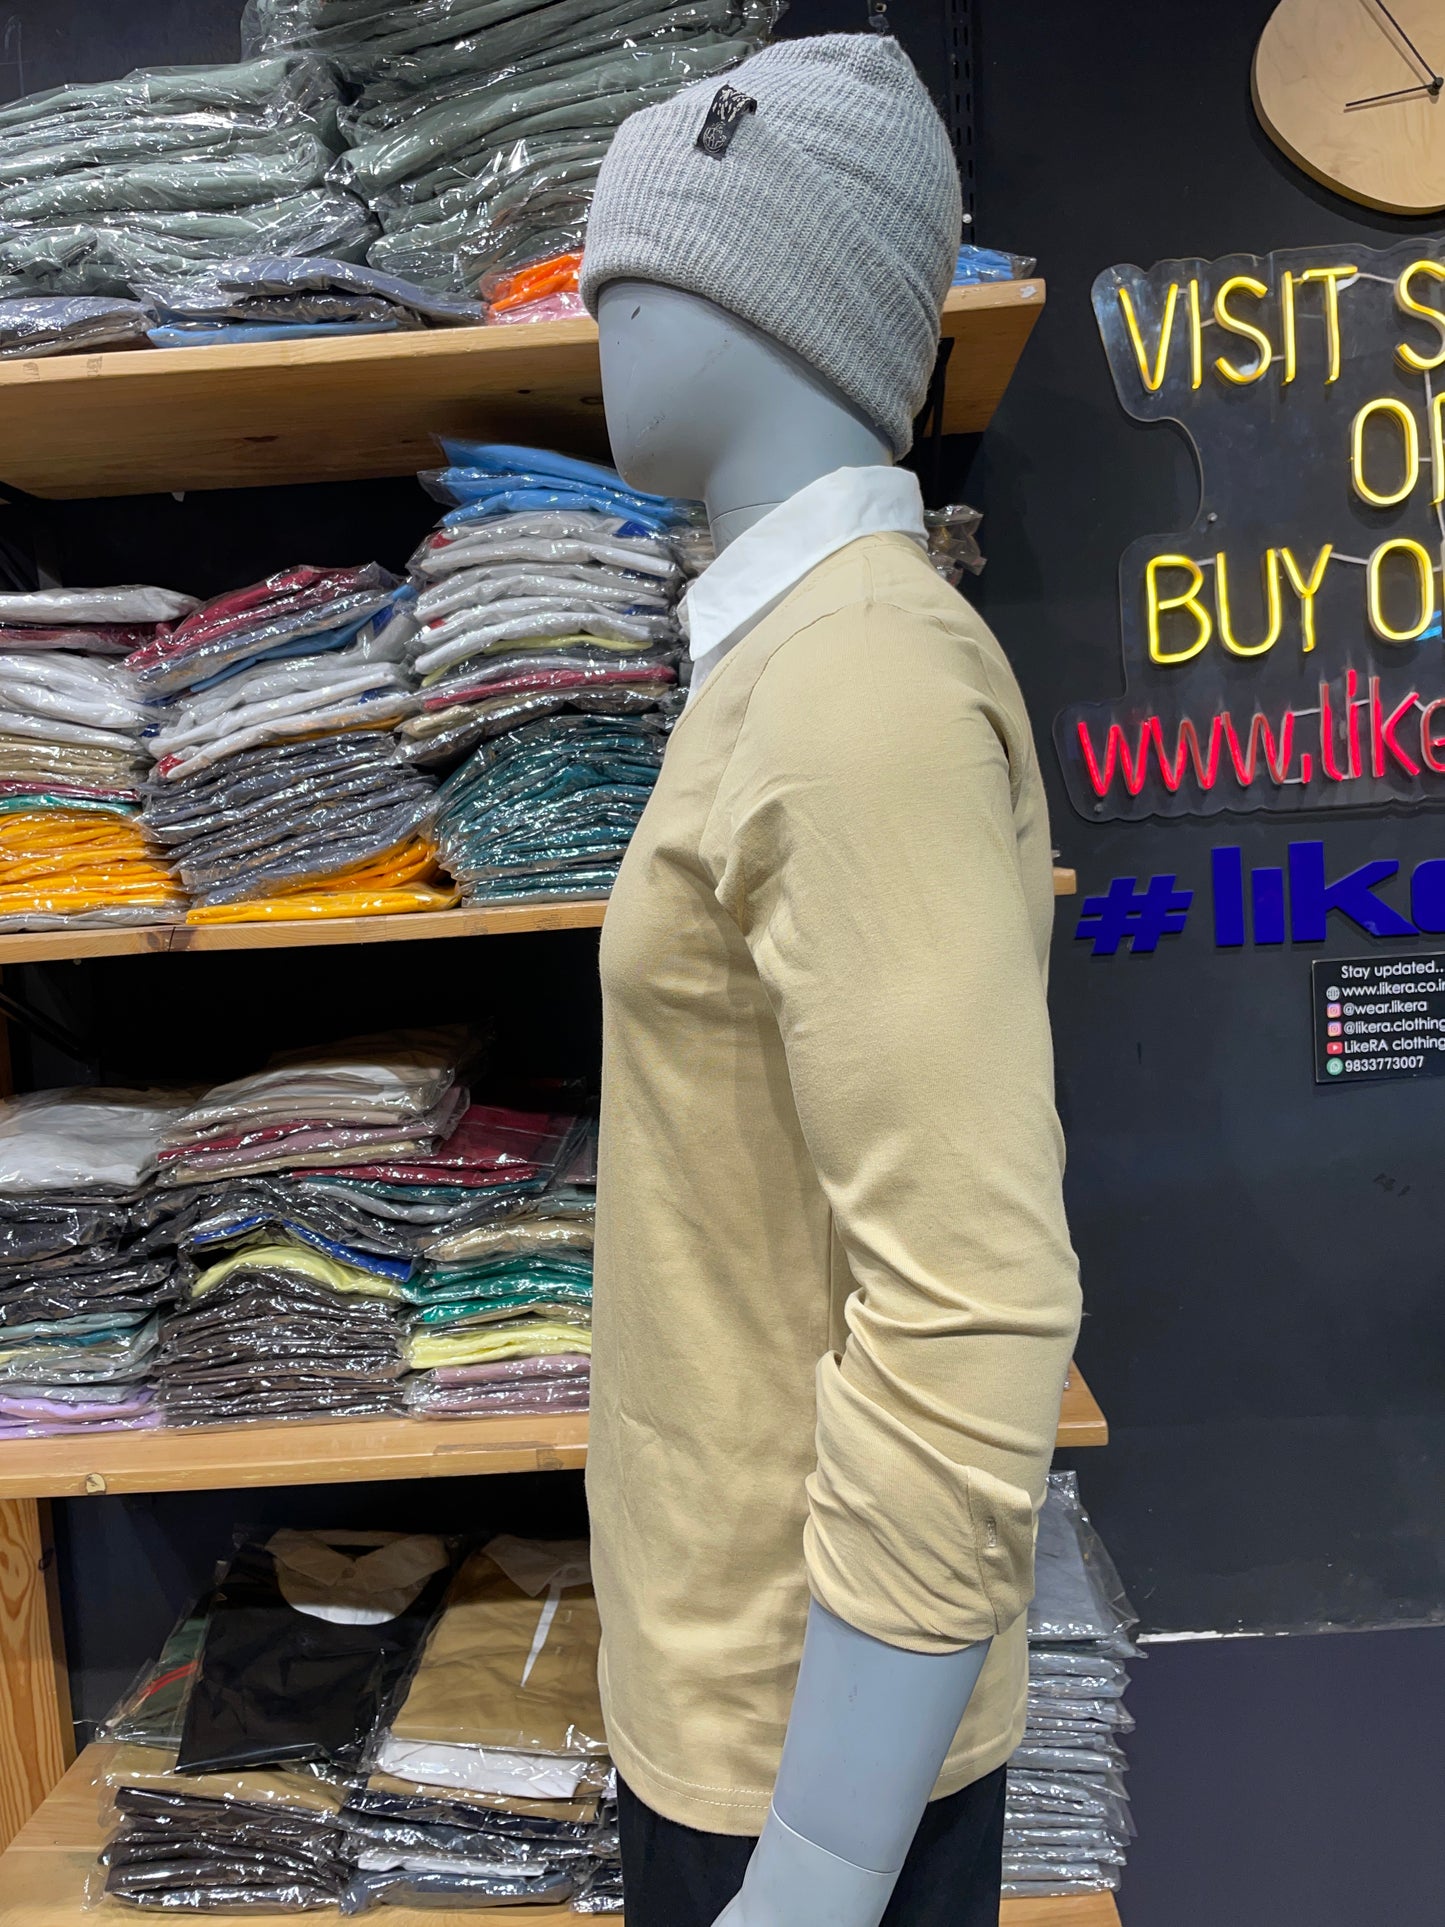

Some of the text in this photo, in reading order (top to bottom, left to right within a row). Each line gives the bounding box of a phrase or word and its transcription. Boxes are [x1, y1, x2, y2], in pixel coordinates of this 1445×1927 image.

[1118, 265, 1358, 392] VISIT
[1145, 543, 1333, 664] BUY
[1341, 965, 1371, 980] Stay
[1343, 1000, 1427, 1016] @wear.likera
[1343, 1017, 1445, 1035] @likera.clothing
[1344, 1035, 1445, 1054] LikeRA clothing
[1344, 1056, 1424, 1072] 9833773007
